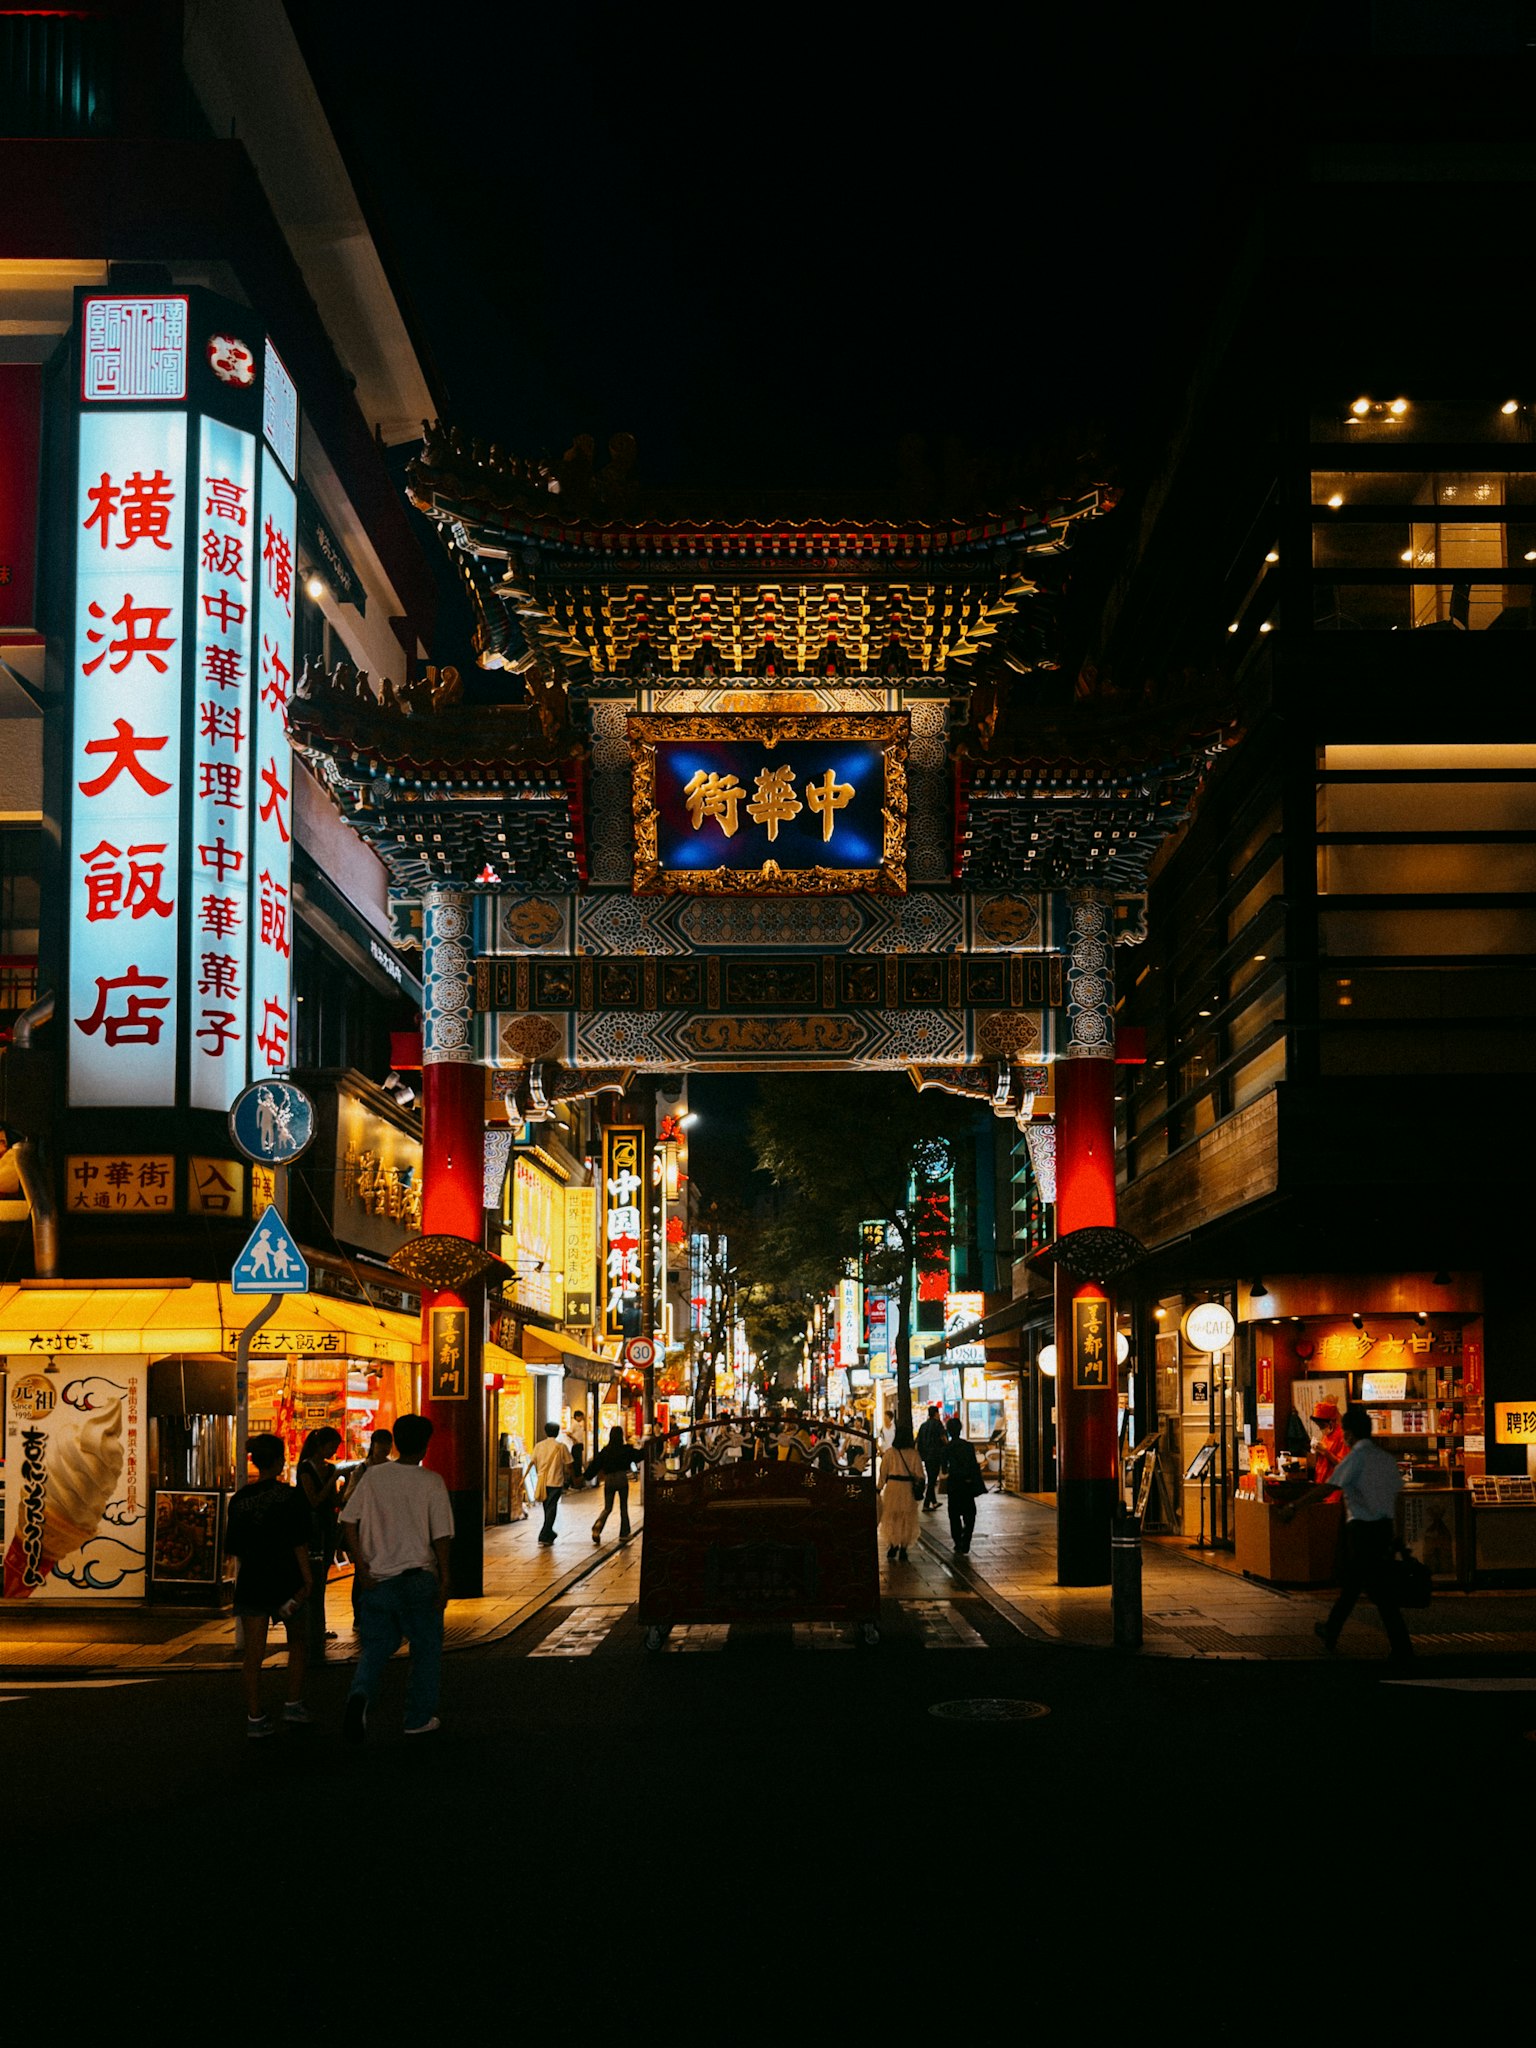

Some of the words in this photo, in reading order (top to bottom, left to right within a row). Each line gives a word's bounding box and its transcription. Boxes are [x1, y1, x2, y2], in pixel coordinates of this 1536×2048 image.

[74, 470, 177, 1047] 横浜大飯店
[257, 514, 294, 1067] 横浜大飯店
[74, 1161, 170, 1189] 中華街
[200, 1164, 236, 1211] 入口
[74, 1191, 168, 1209] 大通り入口
[568, 1194, 580, 1286] 世界一の肉まん
[632, 1345, 650, 1360] 30
[15, 1379, 55, 1410] 元祖
